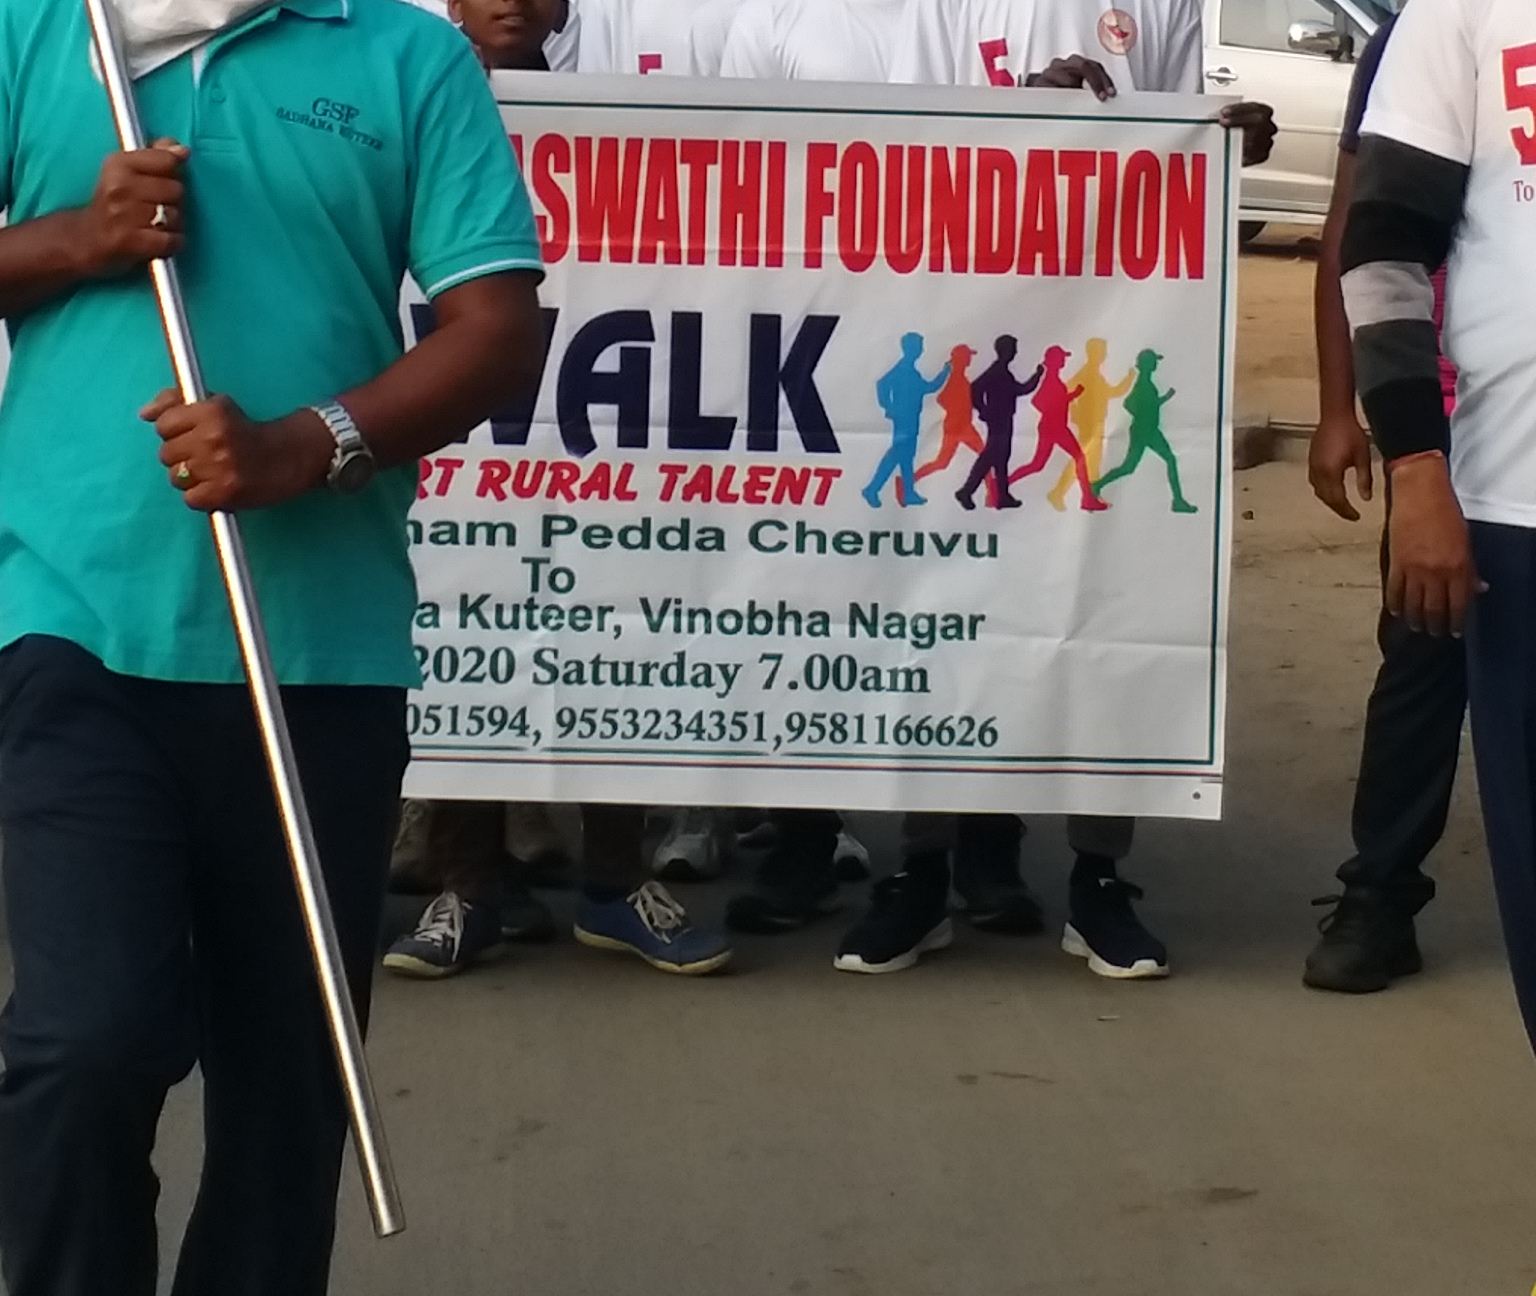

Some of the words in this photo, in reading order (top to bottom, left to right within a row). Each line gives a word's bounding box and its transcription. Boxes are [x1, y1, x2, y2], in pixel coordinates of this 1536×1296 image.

[804, 141, 1208, 280] FOUNDATION
[1514, 180, 1534, 202] To
[475, 459, 638, 504] RURAL
[659, 463, 843, 506] TALENT
[541, 514, 726, 552] Pedda
[748, 519, 999, 558] Cheruvu
[522, 556, 576, 594] To
[459, 593, 622, 640] Kuteer,
[639, 596, 830, 637] Vinobha
[848, 602, 986, 650] Nagar
[532, 646, 743, 698] Saturday
[758, 652, 931, 694] 7.00am
